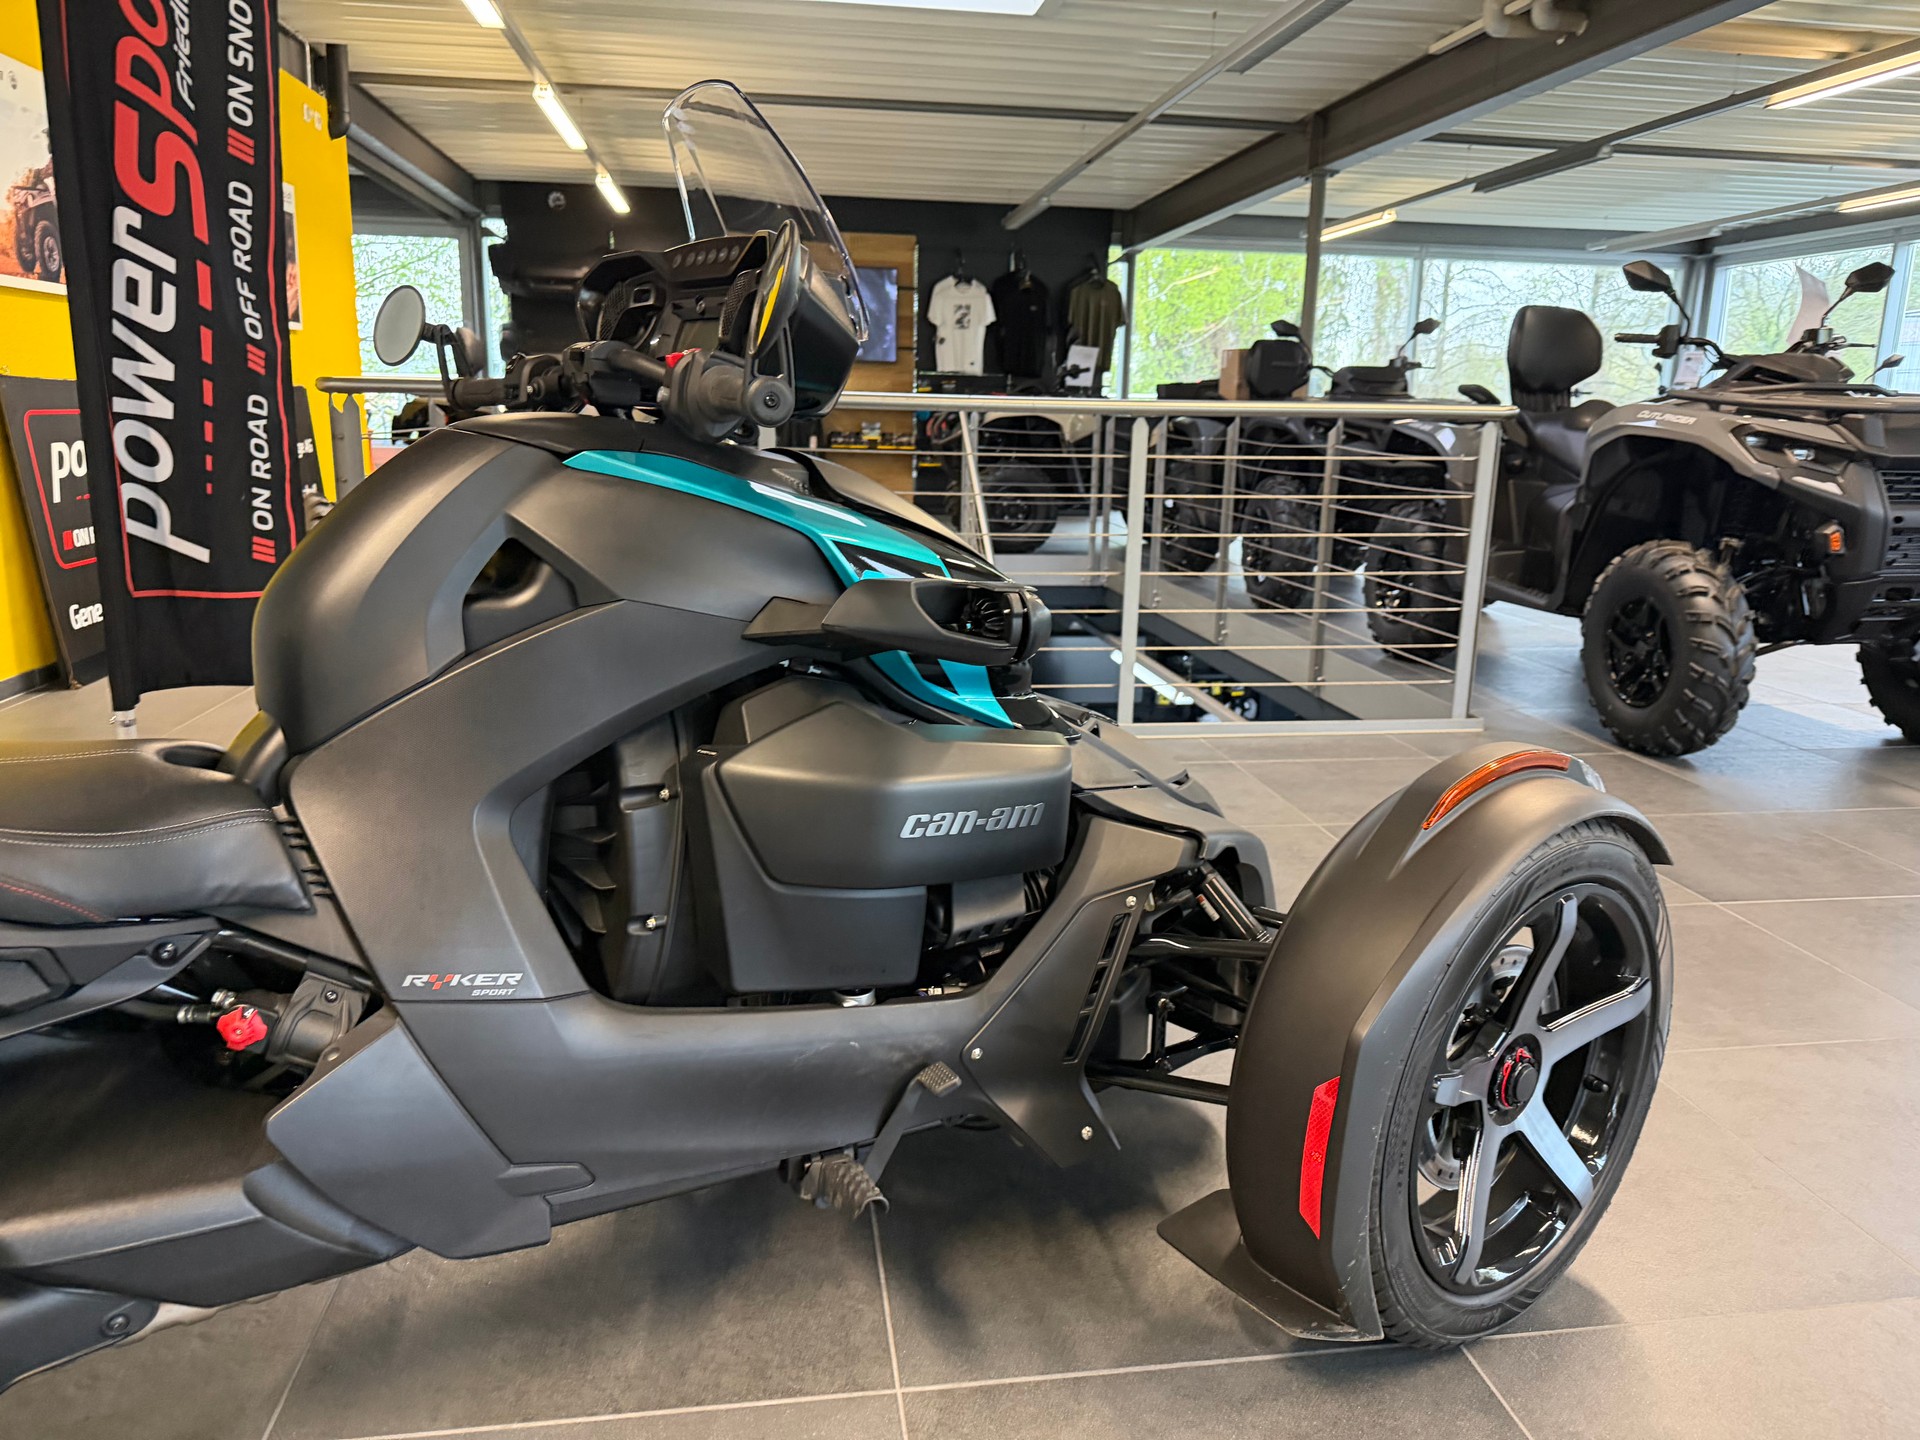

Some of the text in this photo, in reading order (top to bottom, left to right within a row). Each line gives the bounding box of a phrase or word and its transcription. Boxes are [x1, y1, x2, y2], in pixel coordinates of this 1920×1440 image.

[227, 74, 254, 127] ON
[228, 181, 263, 340] OFF ROAD
[247, 394, 274, 531] ON ROAD
[900, 802, 1045, 838] can-am
[401, 972, 523, 990] RYKER
[471, 988, 516, 997] SPORT
